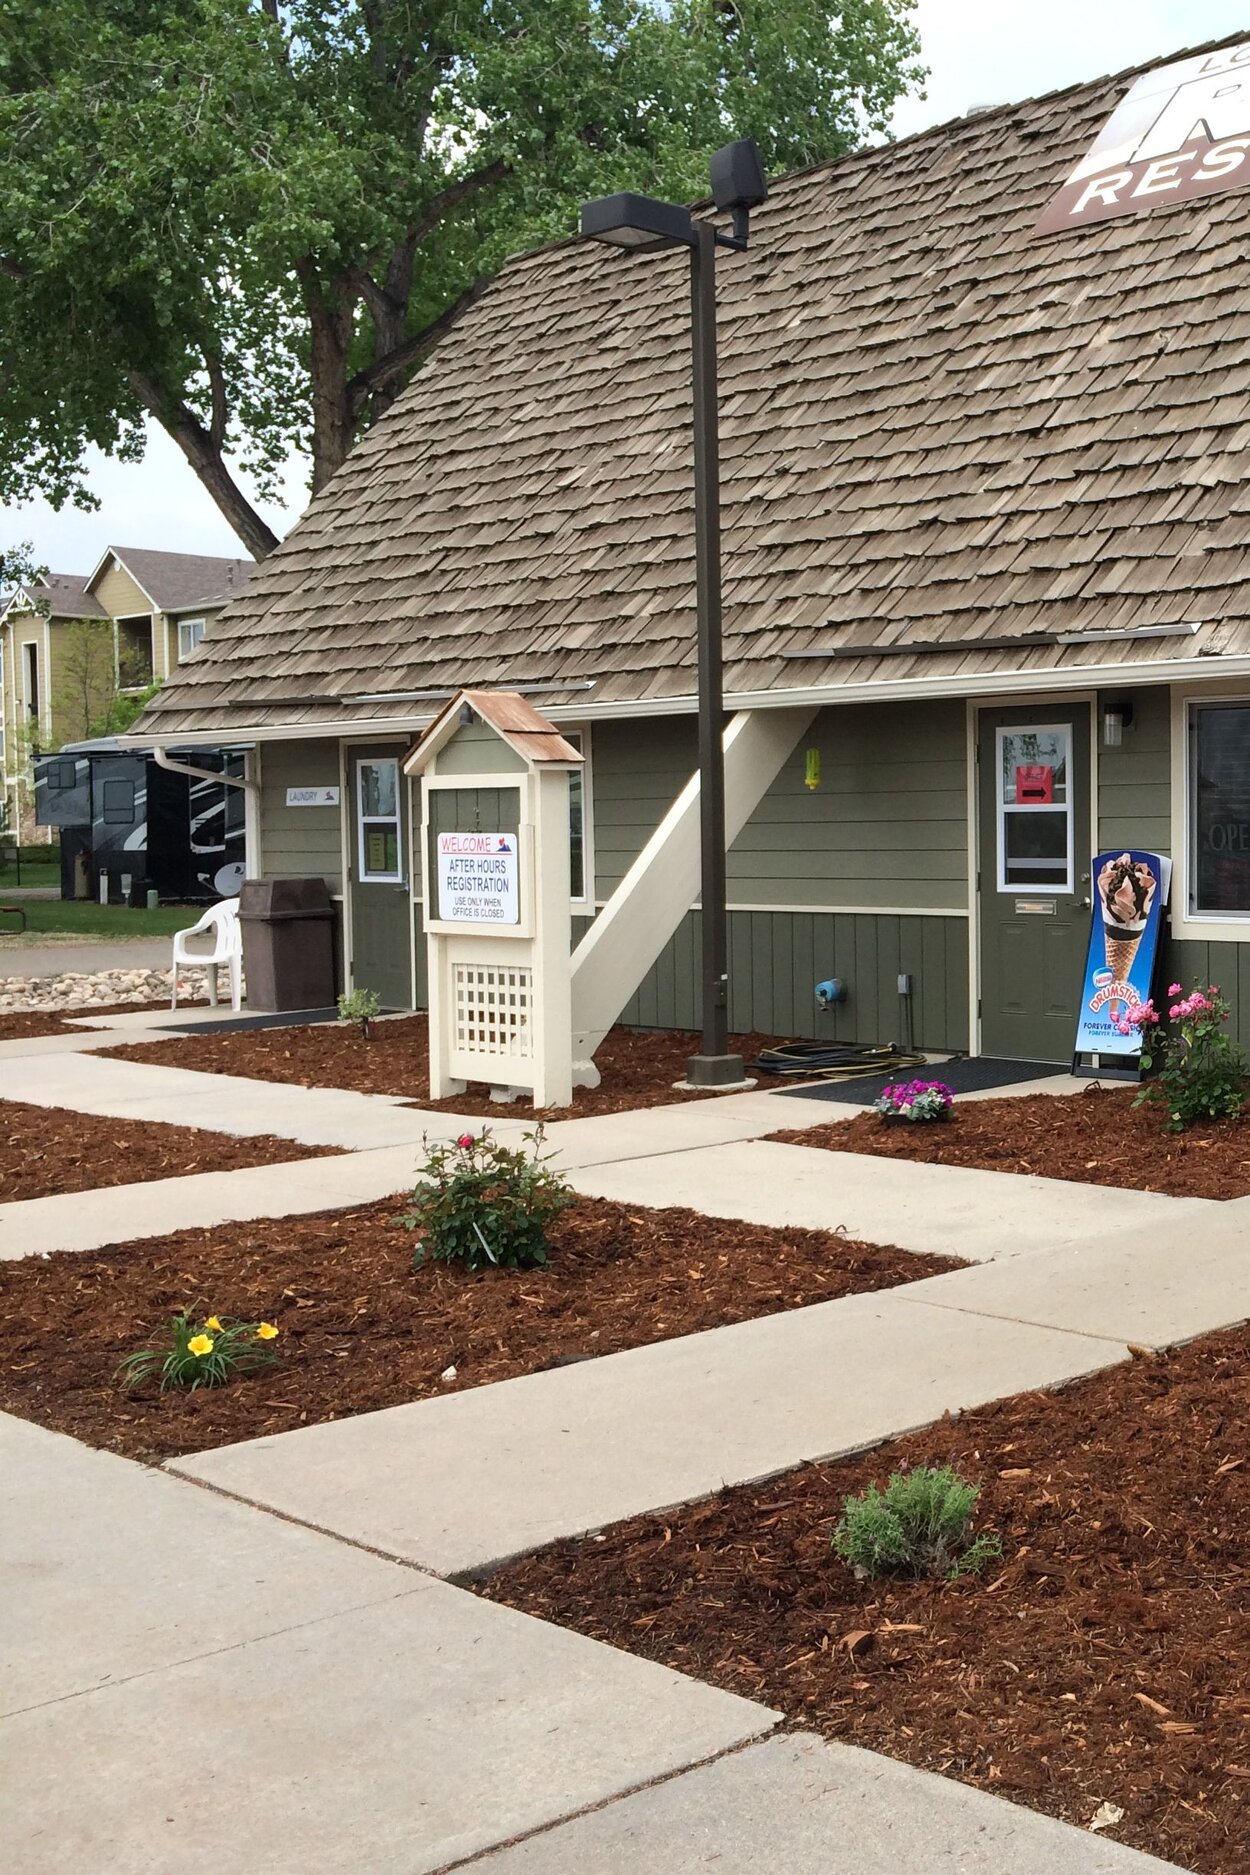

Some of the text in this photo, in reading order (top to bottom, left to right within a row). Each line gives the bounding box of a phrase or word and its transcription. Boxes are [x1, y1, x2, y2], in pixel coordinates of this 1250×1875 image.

[289, 791, 317, 801] LAUNDRY
[441, 837, 491, 852] WELCOME
[449, 859, 506, 874] AFTER HOURS
[447, 876, 509, 893] REGISTRATION
[455, 896, 501, 907] USE ONLY WHEN
[452, 907, 504, 918] OFFICE IS CLOSED
[1090, 983, 1141, 1013] DRUMSTICK
[1083, 1022, 1112, 1031] FOREVER
